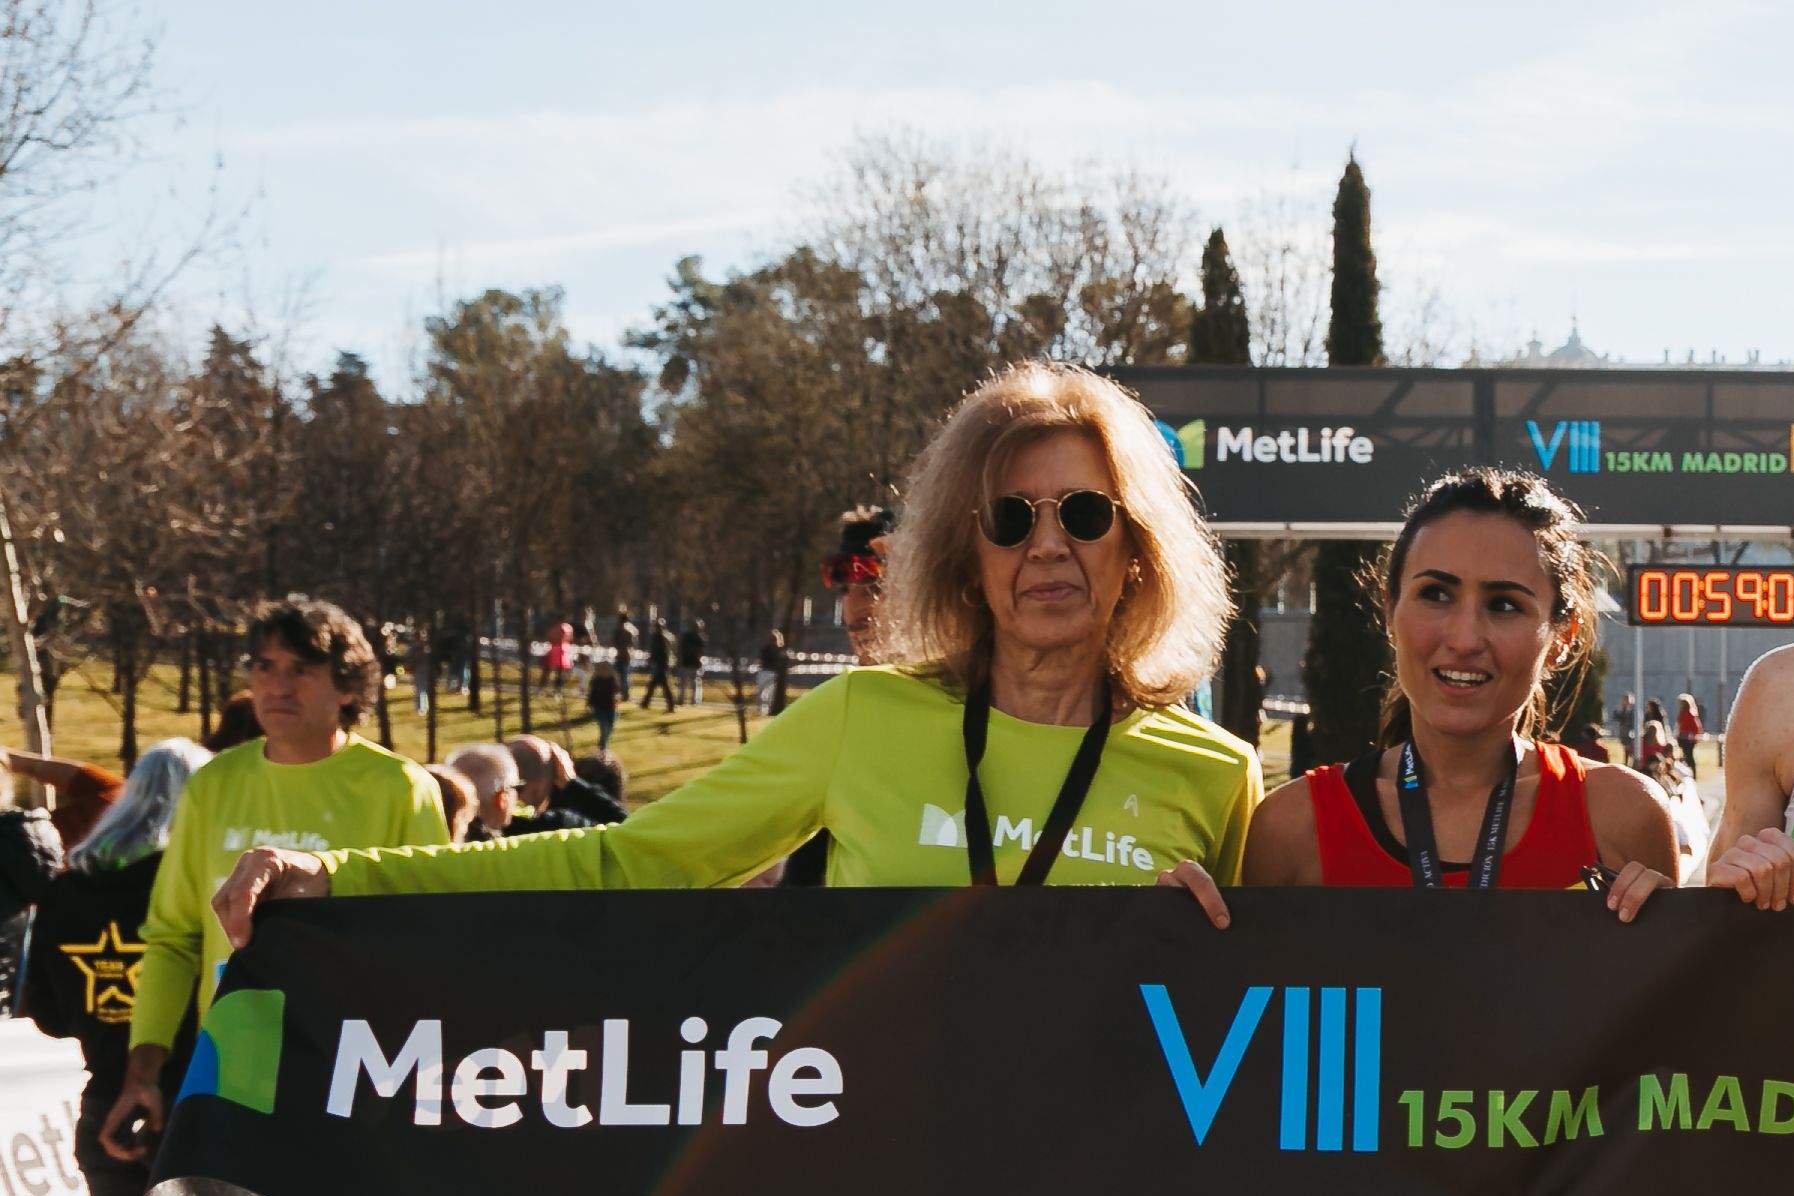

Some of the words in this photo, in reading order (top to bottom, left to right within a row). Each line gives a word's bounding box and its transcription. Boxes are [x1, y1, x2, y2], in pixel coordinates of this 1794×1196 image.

[1216, 426, 1374, 464] MetLife
[1525, 420, 1600, 474] VIII
[1605, 451, 1673, 474] 15KM
[1681, 452, 1788, 475] MADRID
[993, 814, 1154, 871] MtLife
[327, 1016, 844, 1128] MetLife
[1139, 983, 1382, 1152] VIII
[1398, 1086, 1605, 1149] 15KM
